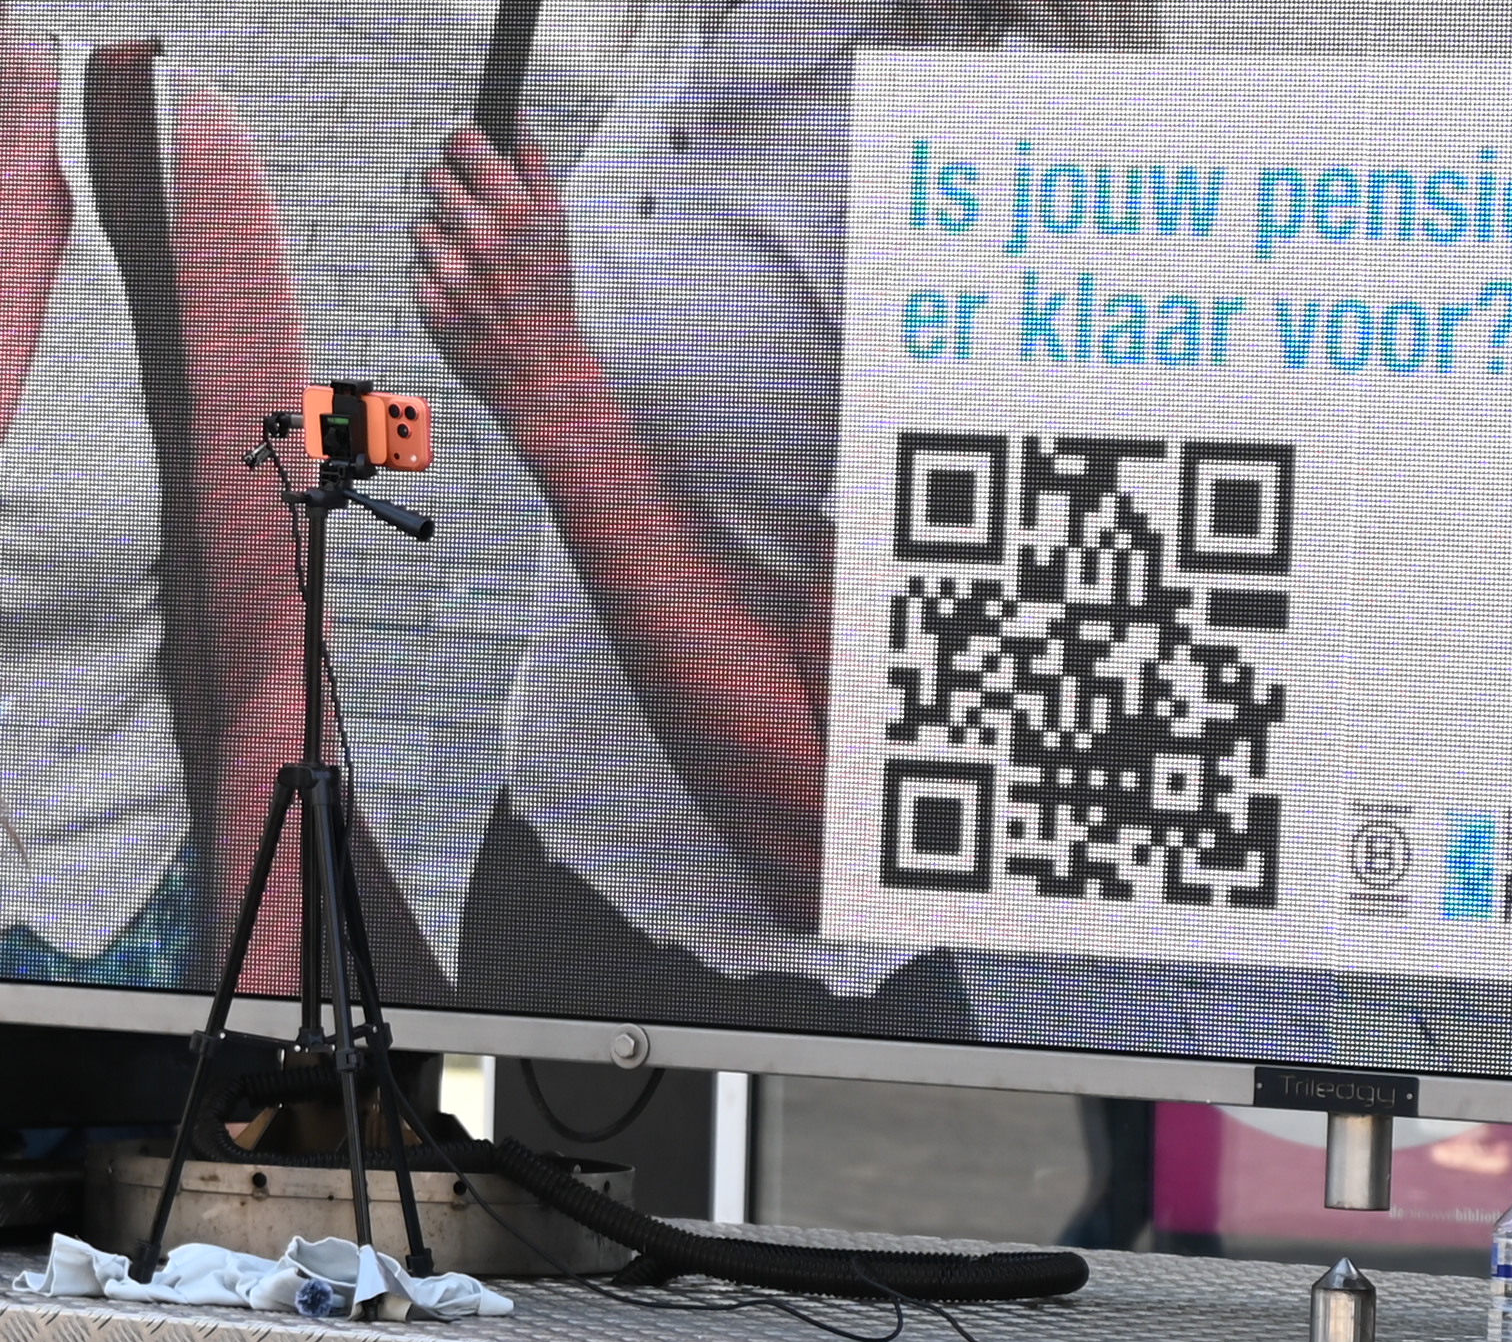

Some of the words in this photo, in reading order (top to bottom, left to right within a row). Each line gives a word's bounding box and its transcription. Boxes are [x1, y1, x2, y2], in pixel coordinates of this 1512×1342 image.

[909, 139, 977, 233] Is
[1004, 140, 1225, 256] jouw
[902, 284, 988, 360] er
[1020, 270, 1244, 366] klaar
